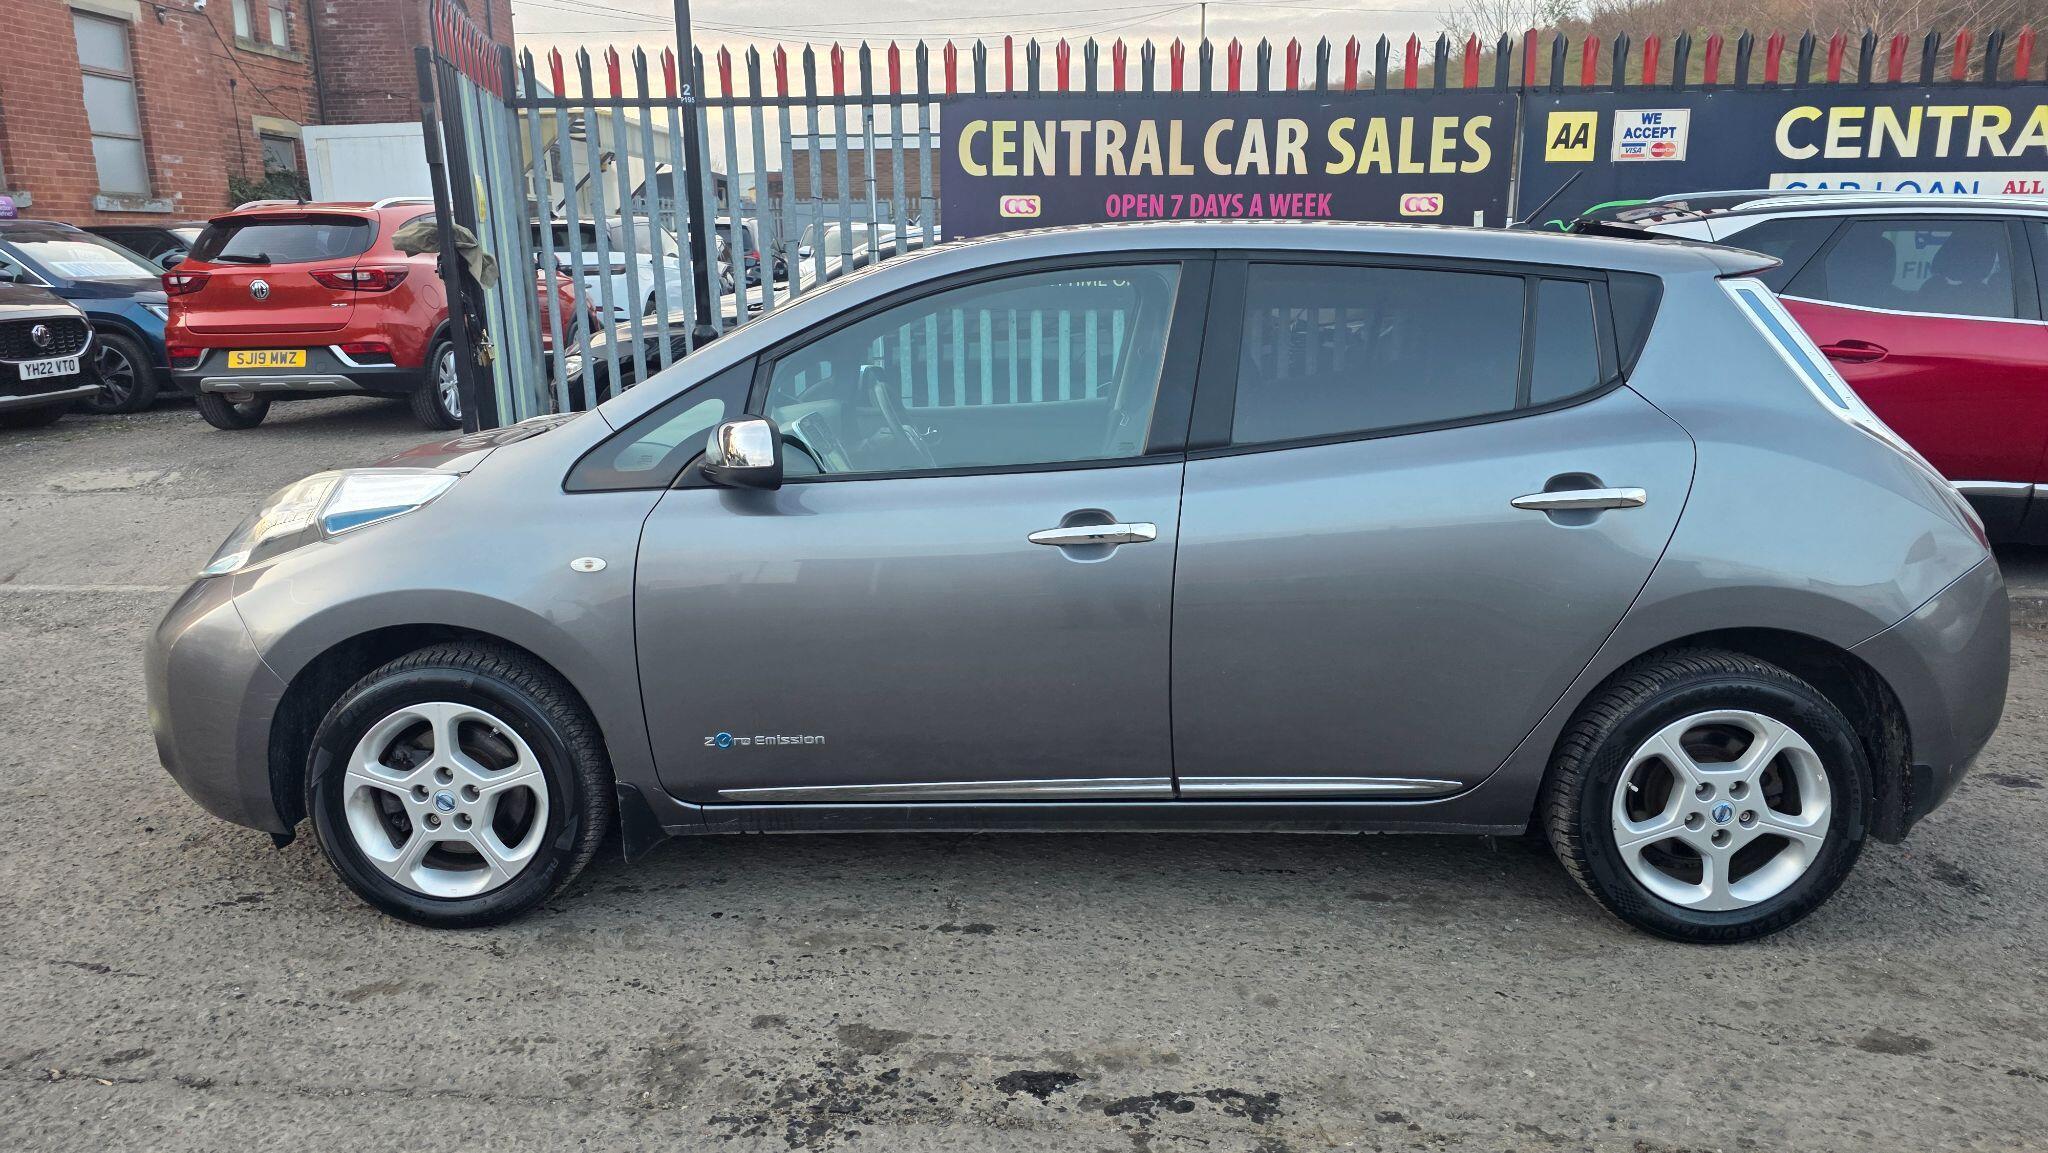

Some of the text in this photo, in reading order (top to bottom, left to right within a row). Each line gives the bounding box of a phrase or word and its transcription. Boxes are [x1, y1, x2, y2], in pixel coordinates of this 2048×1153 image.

[682, 83, 691, 96] 2
[1642, 112, 1662, 125] WE
[1551, 122, 1590, 150] AA
[1623, 126, 1677, 140] ACCEPT
[1775, 104, 2048, 160] CENTRA
[958, 115, 1492, 177] CENTRAL CAR SALES
[2002, 180, 2045, 195] ALL
[1004, 198, 1037, 215] CCS
[1105, 192, 1333, 218] OPEN 7 DAYS A WEEK
[1404, 196, 1439, 213] CCS
[236, 351, 297, 365] SJ19 MWZ
[25, 359, 75, 377] YH22 VTO
[754, 734, 826, 745] Emission
